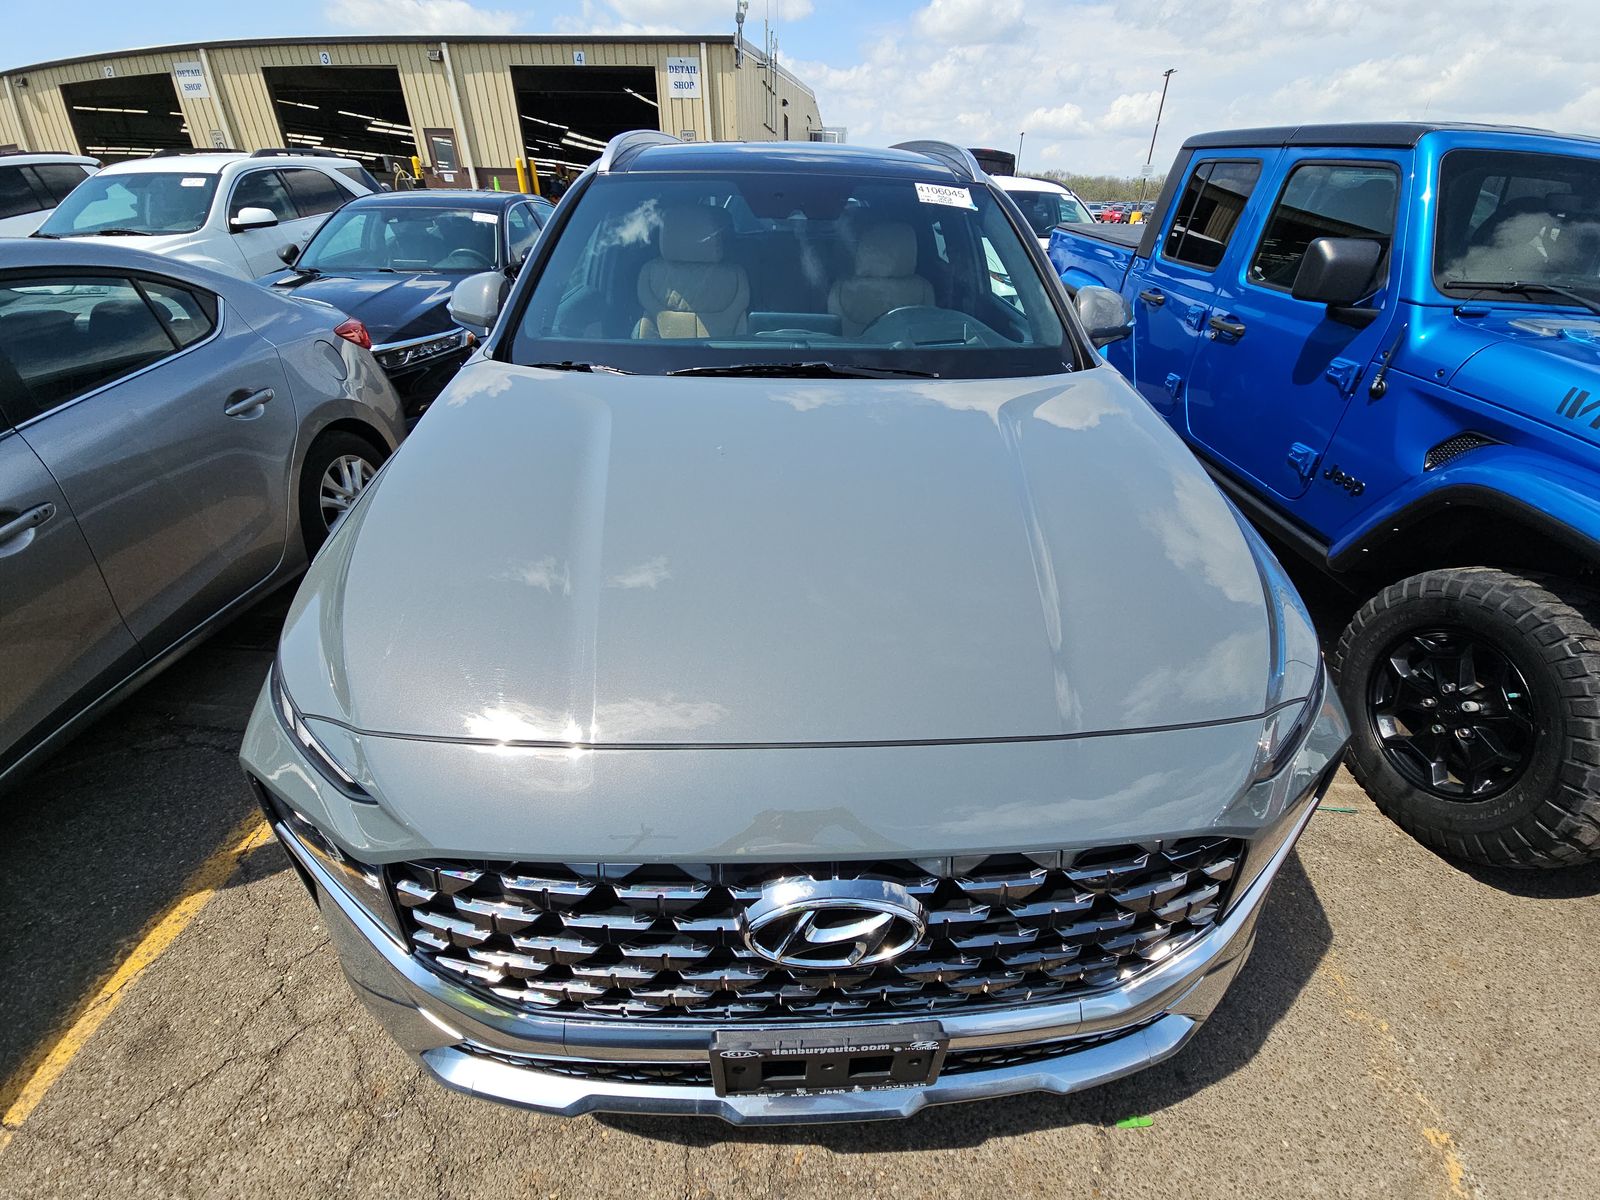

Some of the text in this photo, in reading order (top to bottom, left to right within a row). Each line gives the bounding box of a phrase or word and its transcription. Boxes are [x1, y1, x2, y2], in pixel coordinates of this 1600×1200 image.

[321, 53, 328, 64] 3
[577, 53, 583, 64] 4
[106, 67, 112, 77] 2
[176, 68, 202, 77] DETAIL
[668, 66, 698, 74] DETAIL
[184, 83, 202, 91] SHOP
[673, 81, 695, 89] SHOP
[918, 185, 965, 199] 4106045
[1323, 463, 1366, 497] Jeep
[771, 1044, 890, 1056] danburyauto.com
